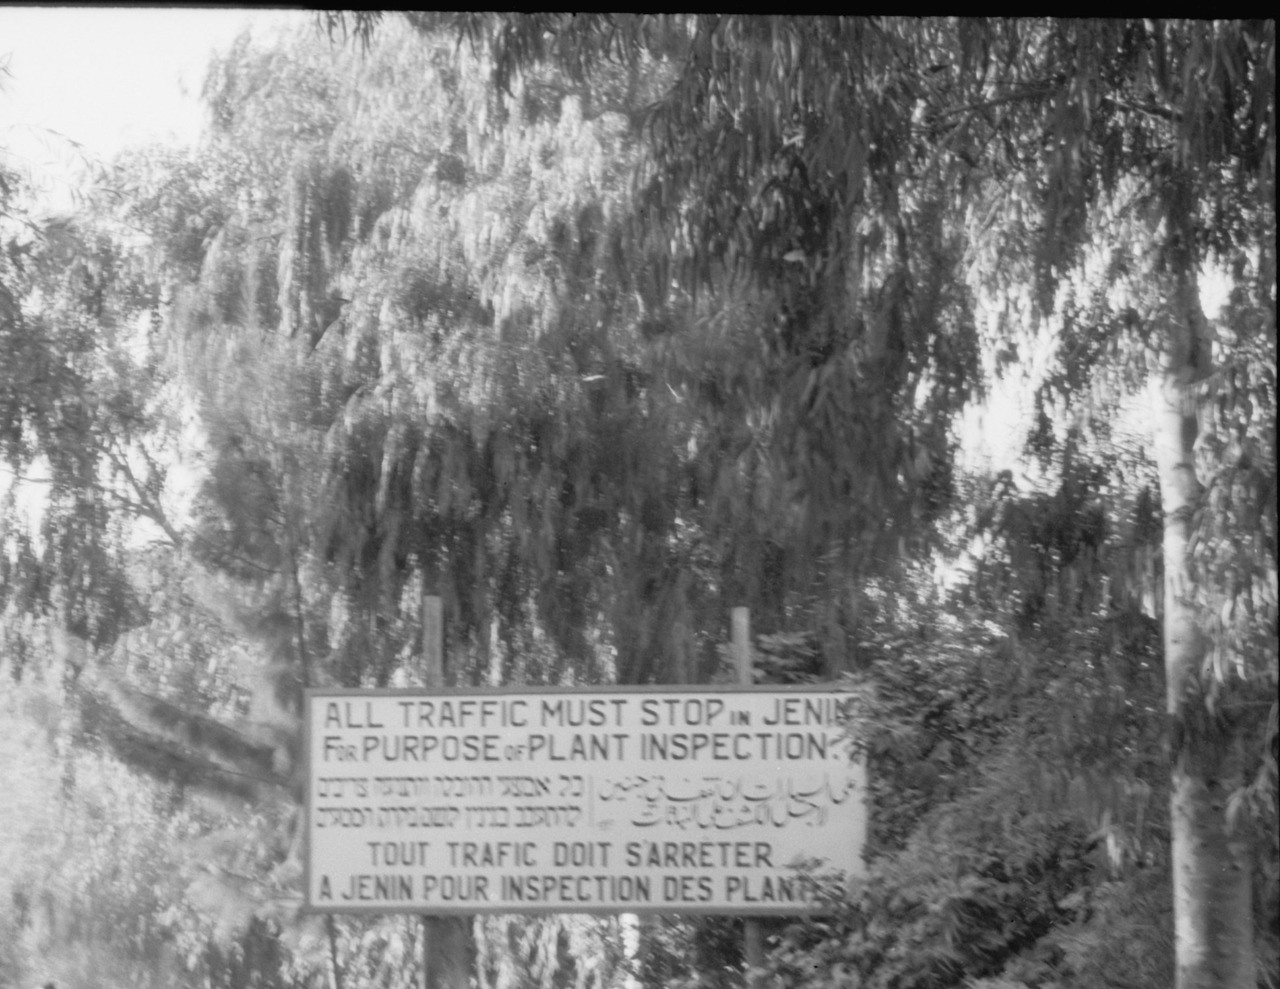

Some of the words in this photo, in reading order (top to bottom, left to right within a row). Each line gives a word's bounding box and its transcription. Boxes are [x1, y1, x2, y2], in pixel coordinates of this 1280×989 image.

[324, 701, 384, 729] ALL
[398, 700, 528, 728] TRAFFIC
[541, 699, 627, 728] MUST
[641, 699, 724, 727] STOP
[730, 710, 751, 726] IN
[363, 734, 500, 762] PURPOSE
[504, 744, 525, 762] OF
[527, 733, 630, 761] PLANT
[368, 842, 430, 867] TOUT
[446, 842, 537, 867] TRAFIC
[554, 842, 611, 867] DOIT
[320, 874, 333, 900] A
[342, 874, 412, 900] JENIN
[423, 875, 488, 900] POUR
[501, 875, 650, 901] INSPECTION
[664, 875, 713, 901] DES
